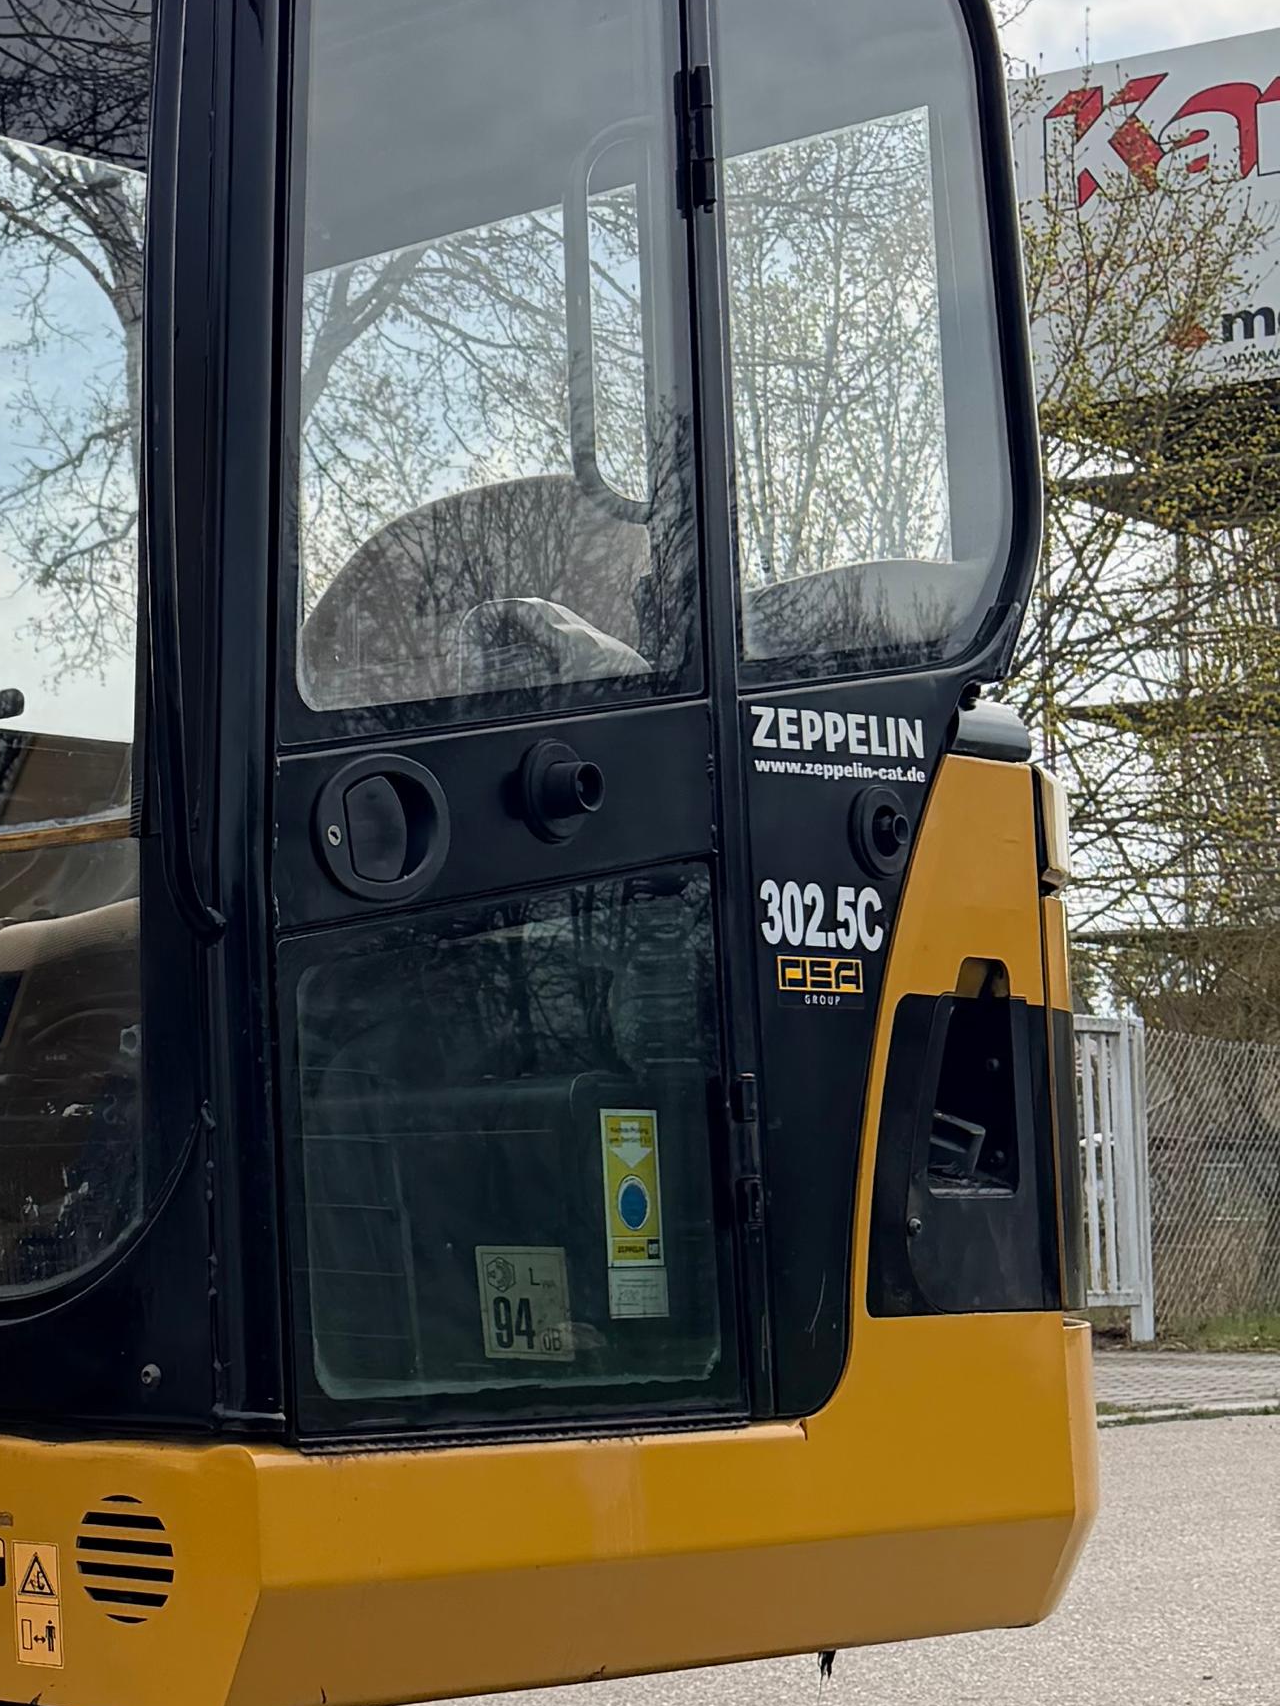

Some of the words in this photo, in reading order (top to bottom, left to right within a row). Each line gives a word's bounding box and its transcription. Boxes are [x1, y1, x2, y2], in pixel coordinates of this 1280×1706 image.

[750, 705, 925, 759] ZEPPELIN
[754, 759, 926, 783] www.zeppelin-cat.de
[760, 879, 884, 952] 302.5C
[804, 994, 841, 1006] GROUP
[493, 1296, 536, 1349] 94
